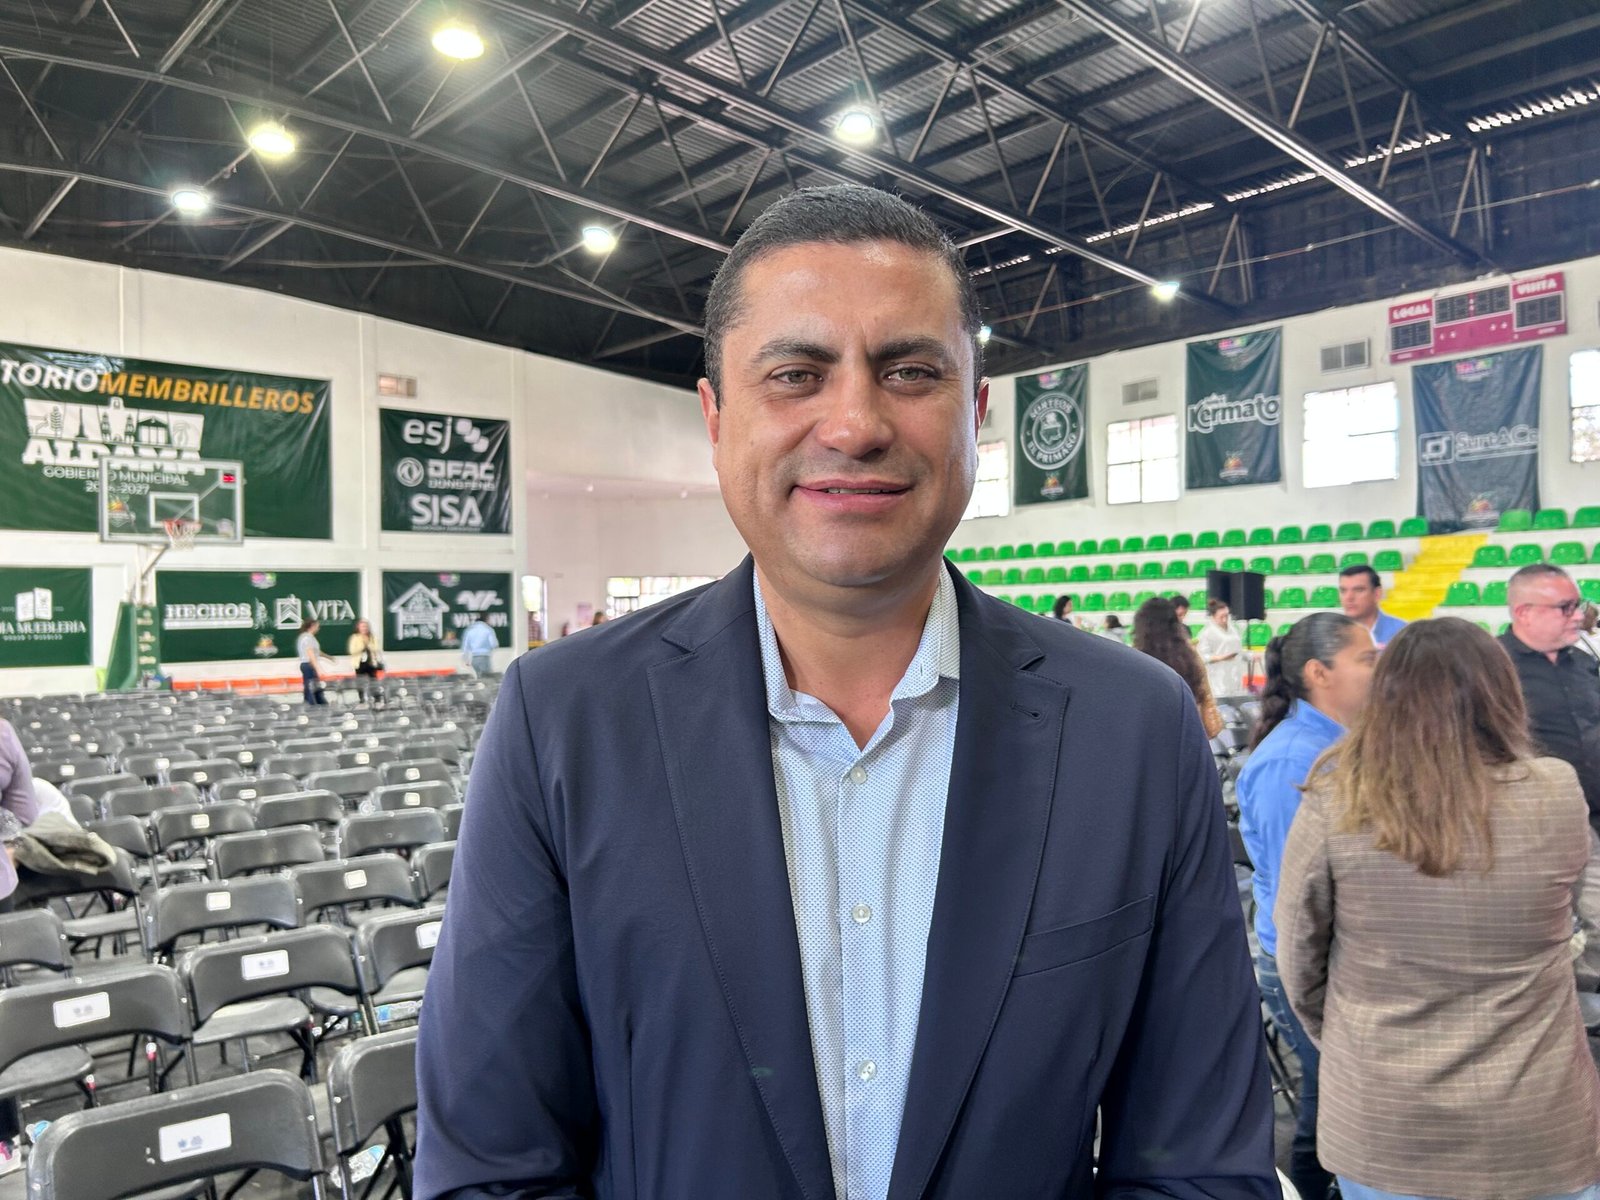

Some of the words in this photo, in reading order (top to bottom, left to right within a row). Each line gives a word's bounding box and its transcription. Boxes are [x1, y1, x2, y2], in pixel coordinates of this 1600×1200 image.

[1187, 393, 1281, 434] Kermato
[403, 417, 453, 454] esj
[43, 466, 117, 481] GOBIERO
[119, 470, 189, 486] MUNICIPAL
[410, 493, 483, 526] SISA
[164, 603, 252, 621] HECHOS
[307, 600, 356, 621] VITA
